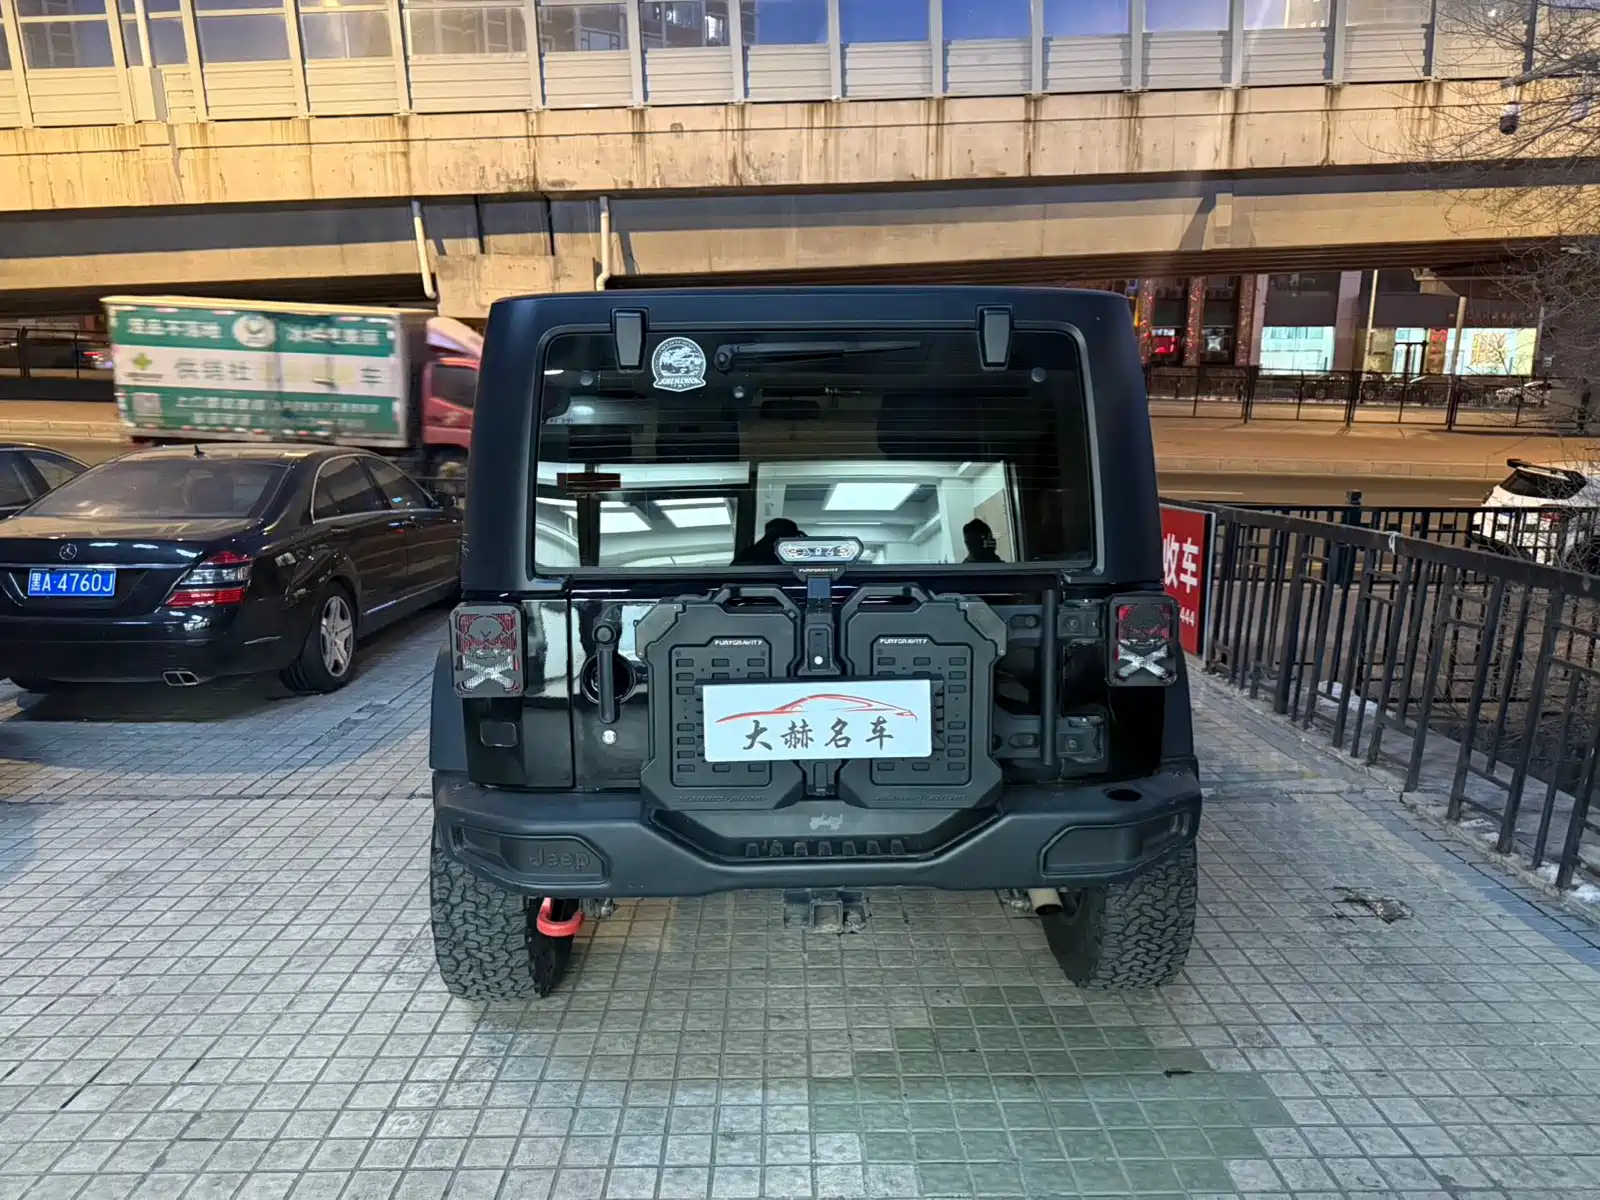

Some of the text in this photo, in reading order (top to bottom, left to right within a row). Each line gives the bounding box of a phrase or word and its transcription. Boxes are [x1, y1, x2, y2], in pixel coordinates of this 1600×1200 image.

[1163, 533, 1199, 593] 收车
[743, 715, 893, 751] 大赫名车
[528, 848, 591, 871] Jeep
